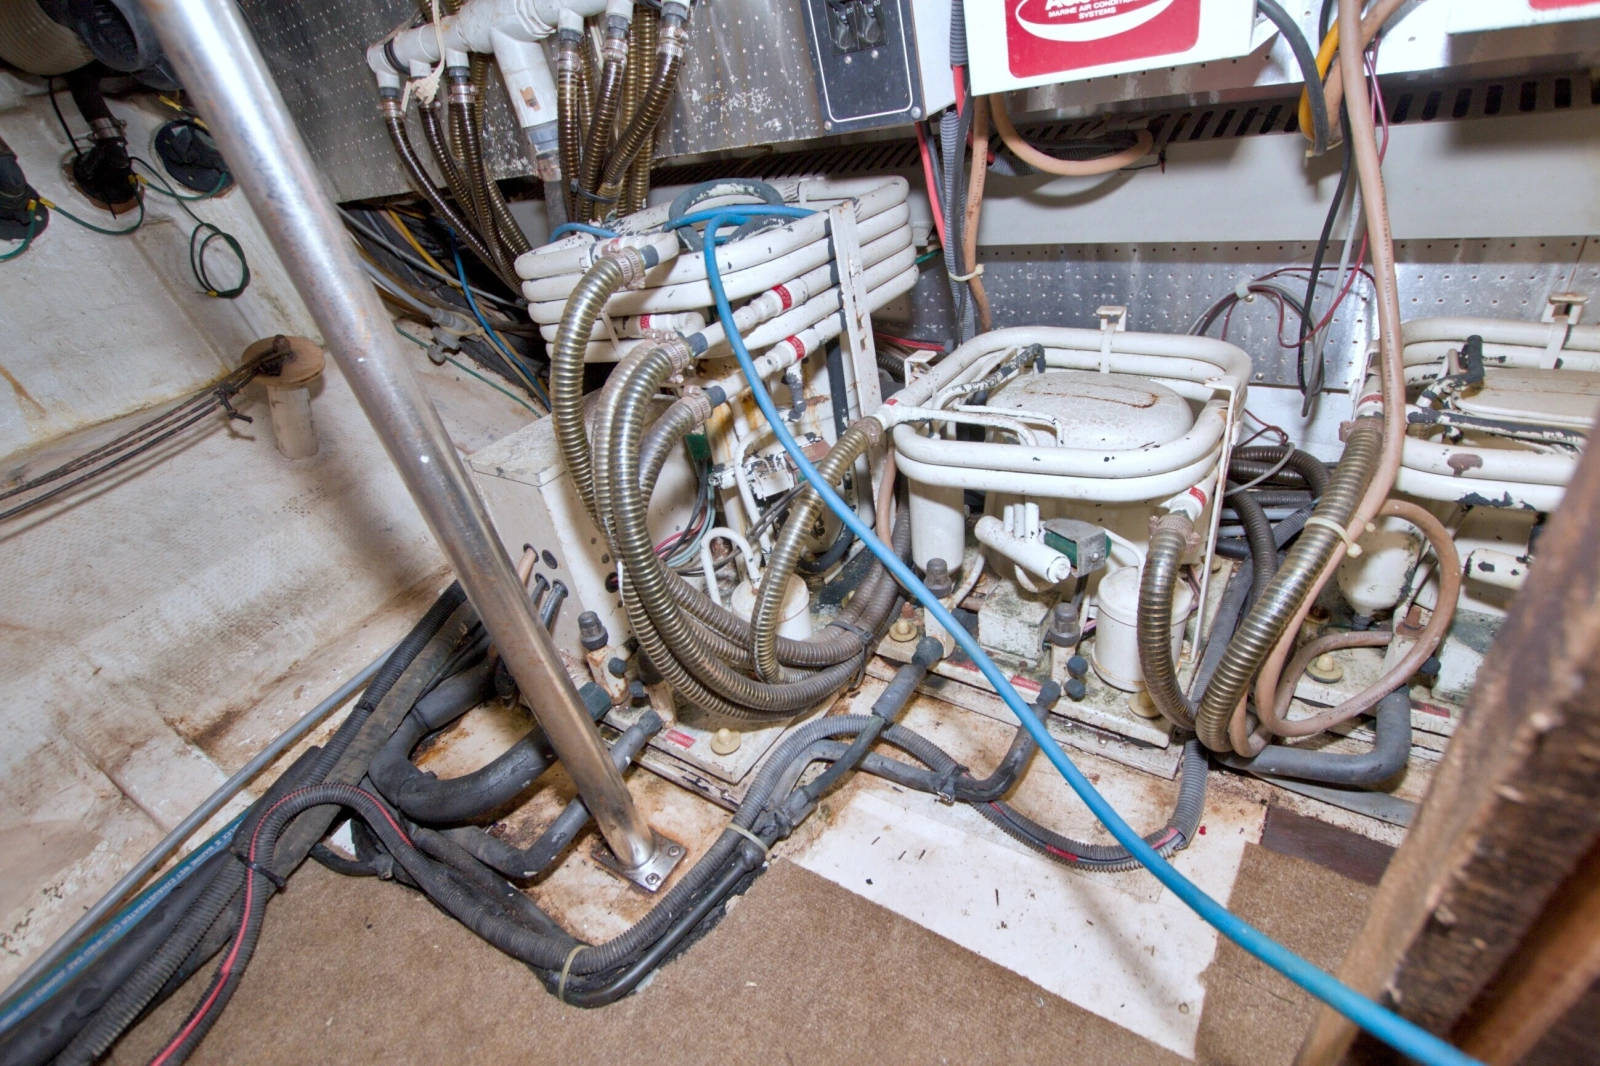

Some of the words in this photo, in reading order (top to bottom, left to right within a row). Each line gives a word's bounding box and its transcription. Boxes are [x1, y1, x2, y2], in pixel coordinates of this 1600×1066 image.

[1048, 6, 1078, 18] MARINE
[1079, 4, 1092, 12] AIR
[1078, 7, 1117, 19] SYSTEMS
[189, 844, 214, 866] MARINE
[175, 864, 191, 878] WET
